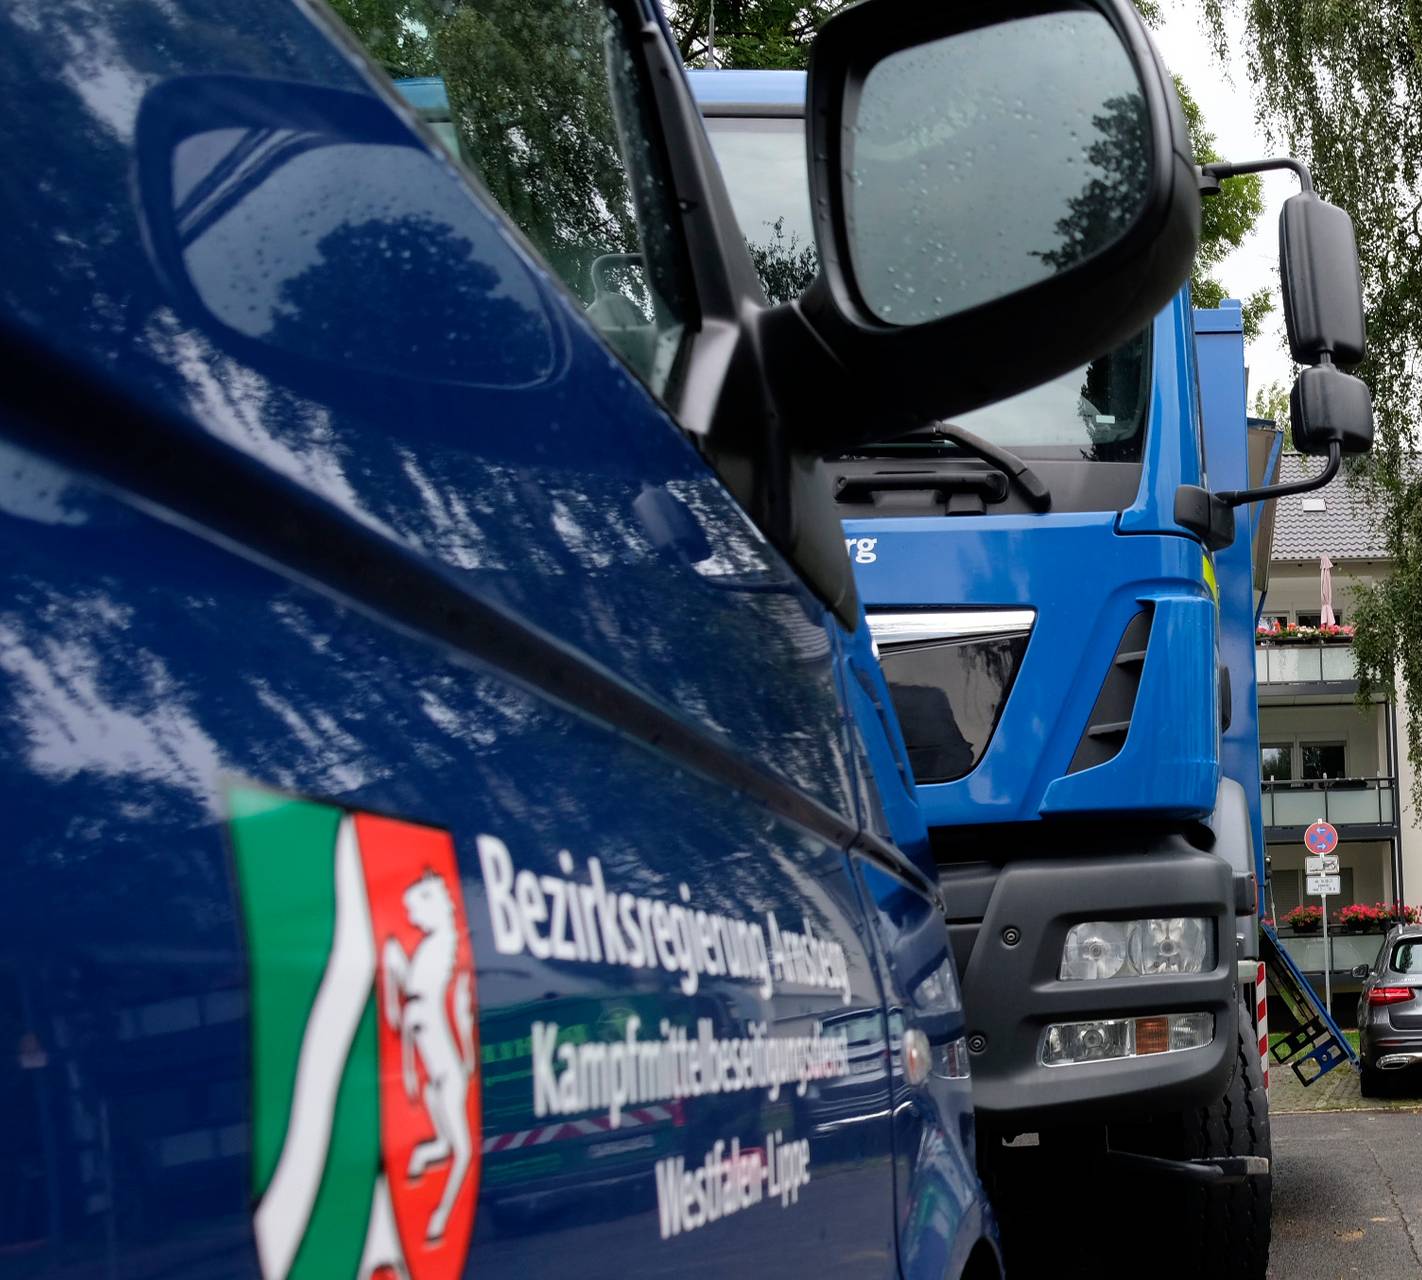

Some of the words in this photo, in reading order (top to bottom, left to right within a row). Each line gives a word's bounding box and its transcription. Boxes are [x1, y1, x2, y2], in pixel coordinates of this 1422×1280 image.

[477, 834, 773, 1000] Bezirksregierung
[766, 911, 852, 1006] Arnsberg
[655, 1130, 810, 1239] Westfalen-Lippe
